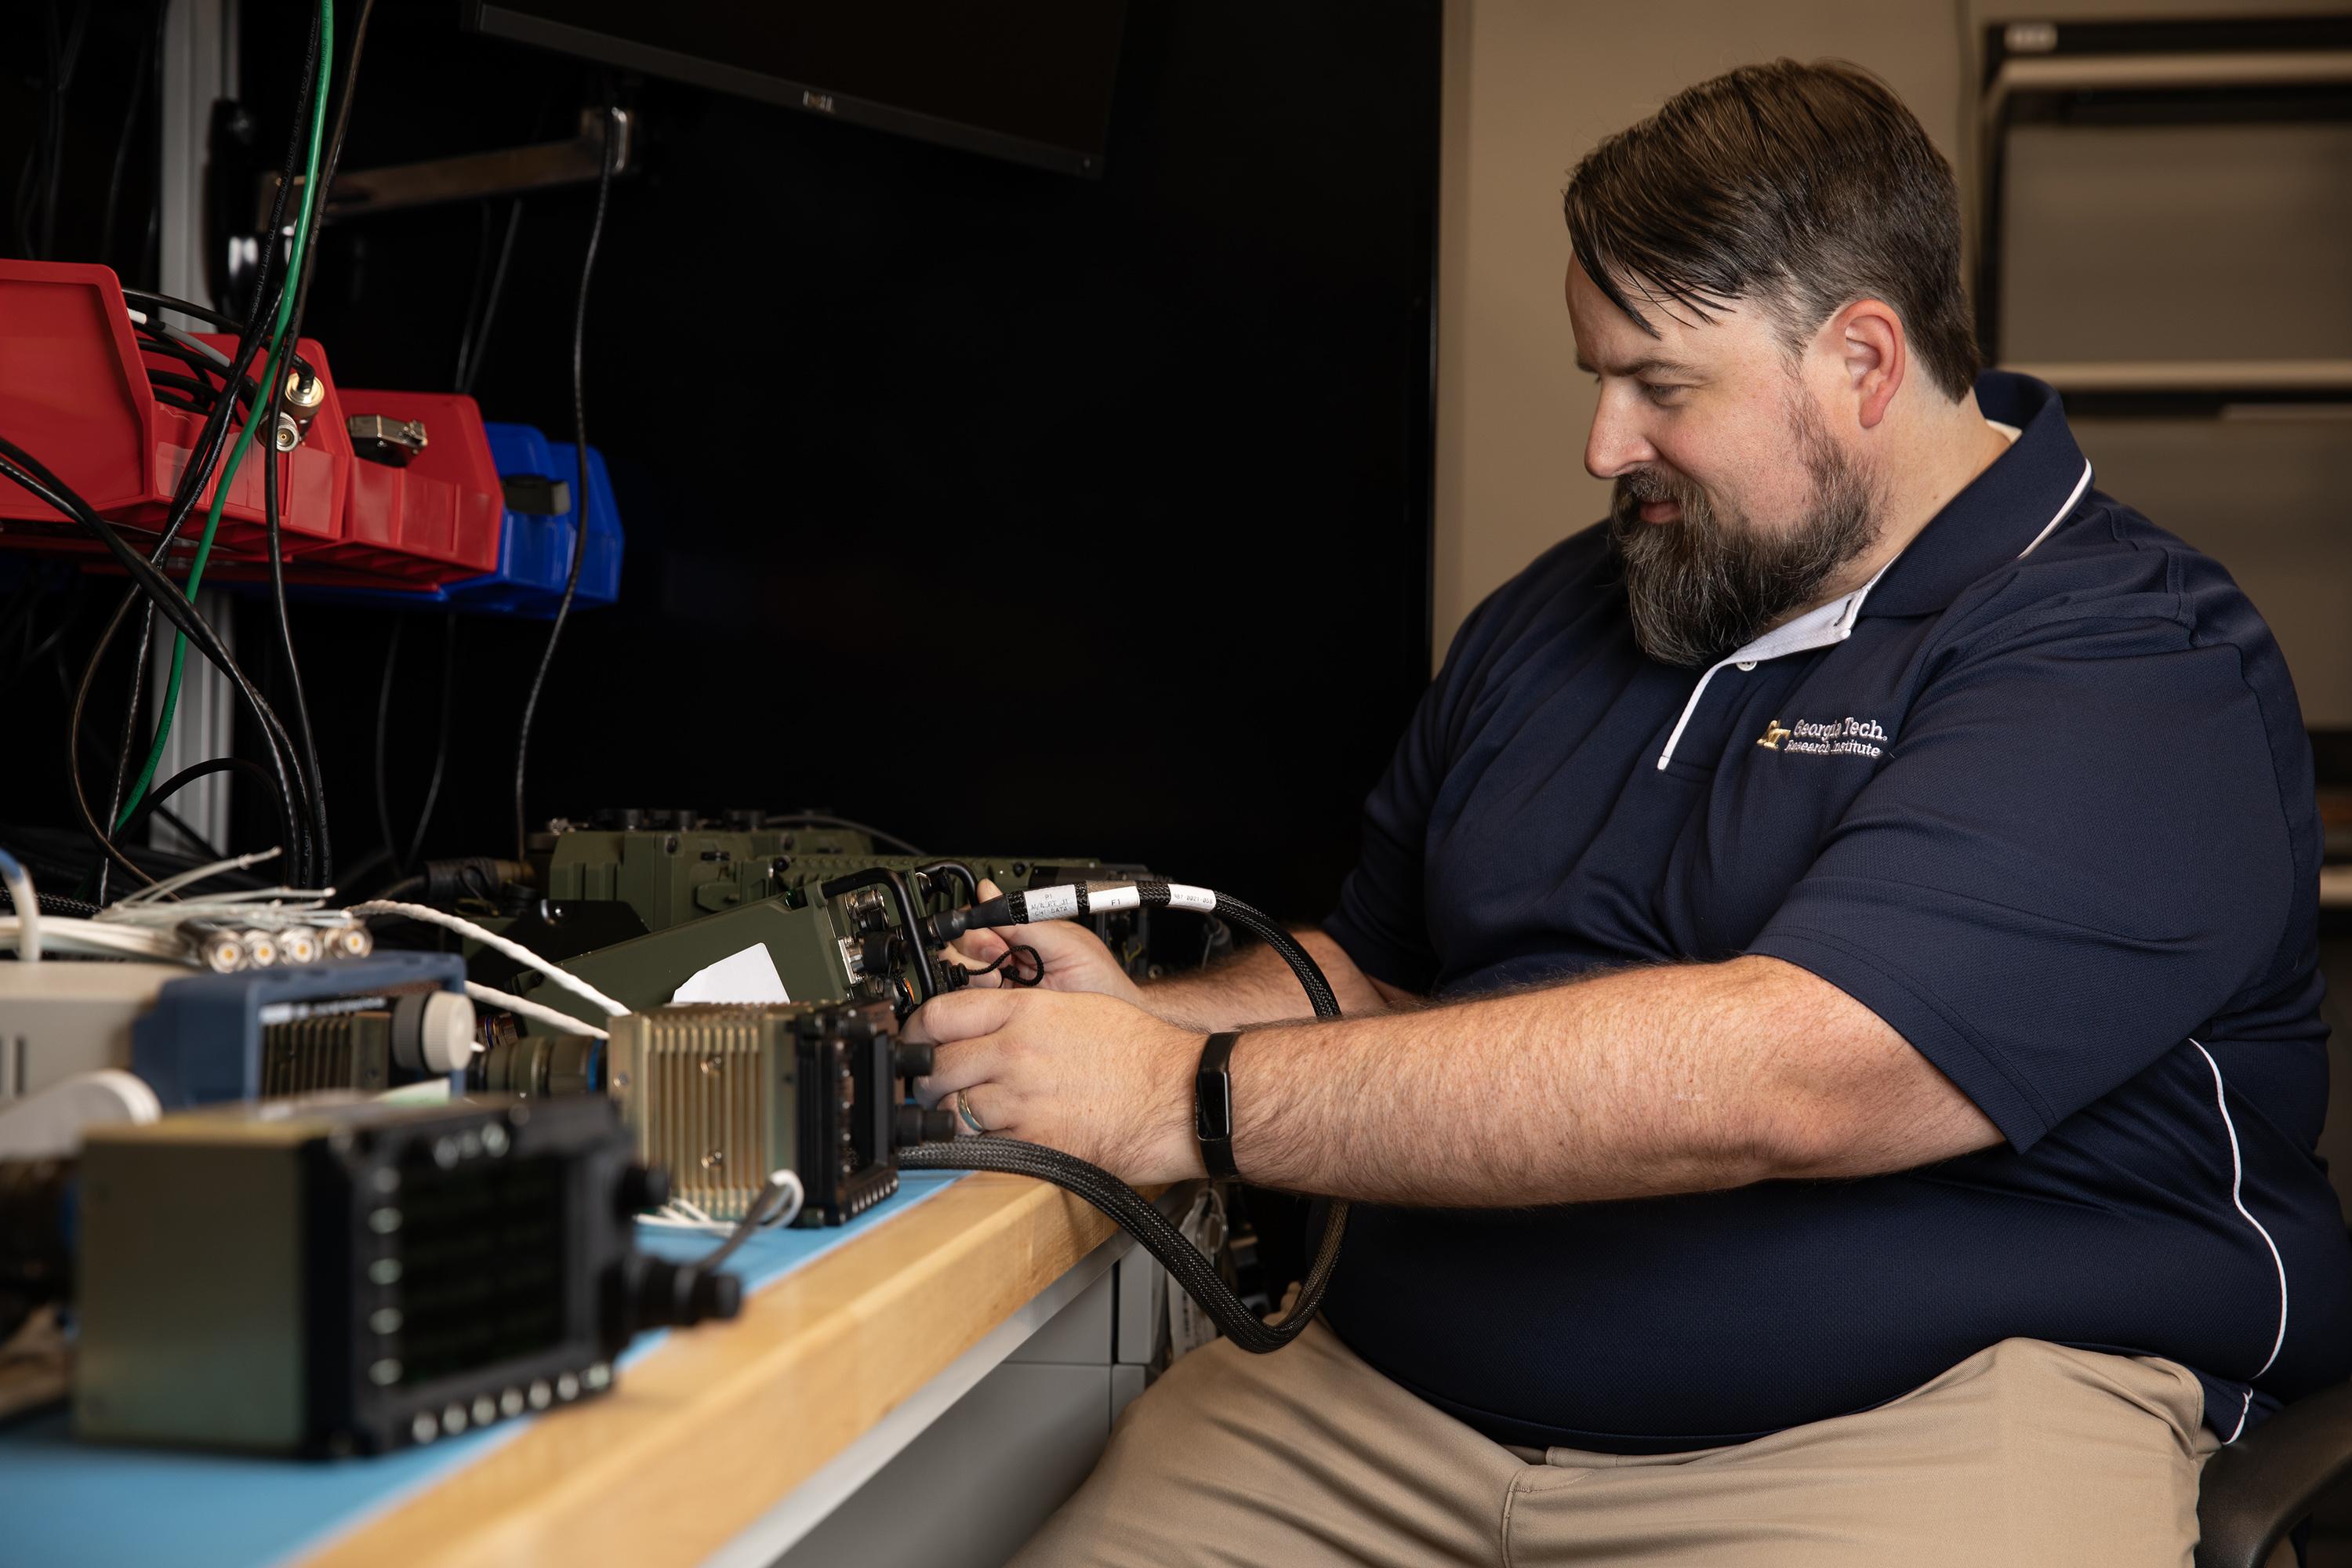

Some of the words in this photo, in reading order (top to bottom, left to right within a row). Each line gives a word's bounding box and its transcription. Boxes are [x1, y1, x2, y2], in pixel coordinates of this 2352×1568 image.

[1794, 719, 1842, 742] Georgia
[1784, 739, 1831, 755] Research
[1831, 739, 1883, 760] Institute
